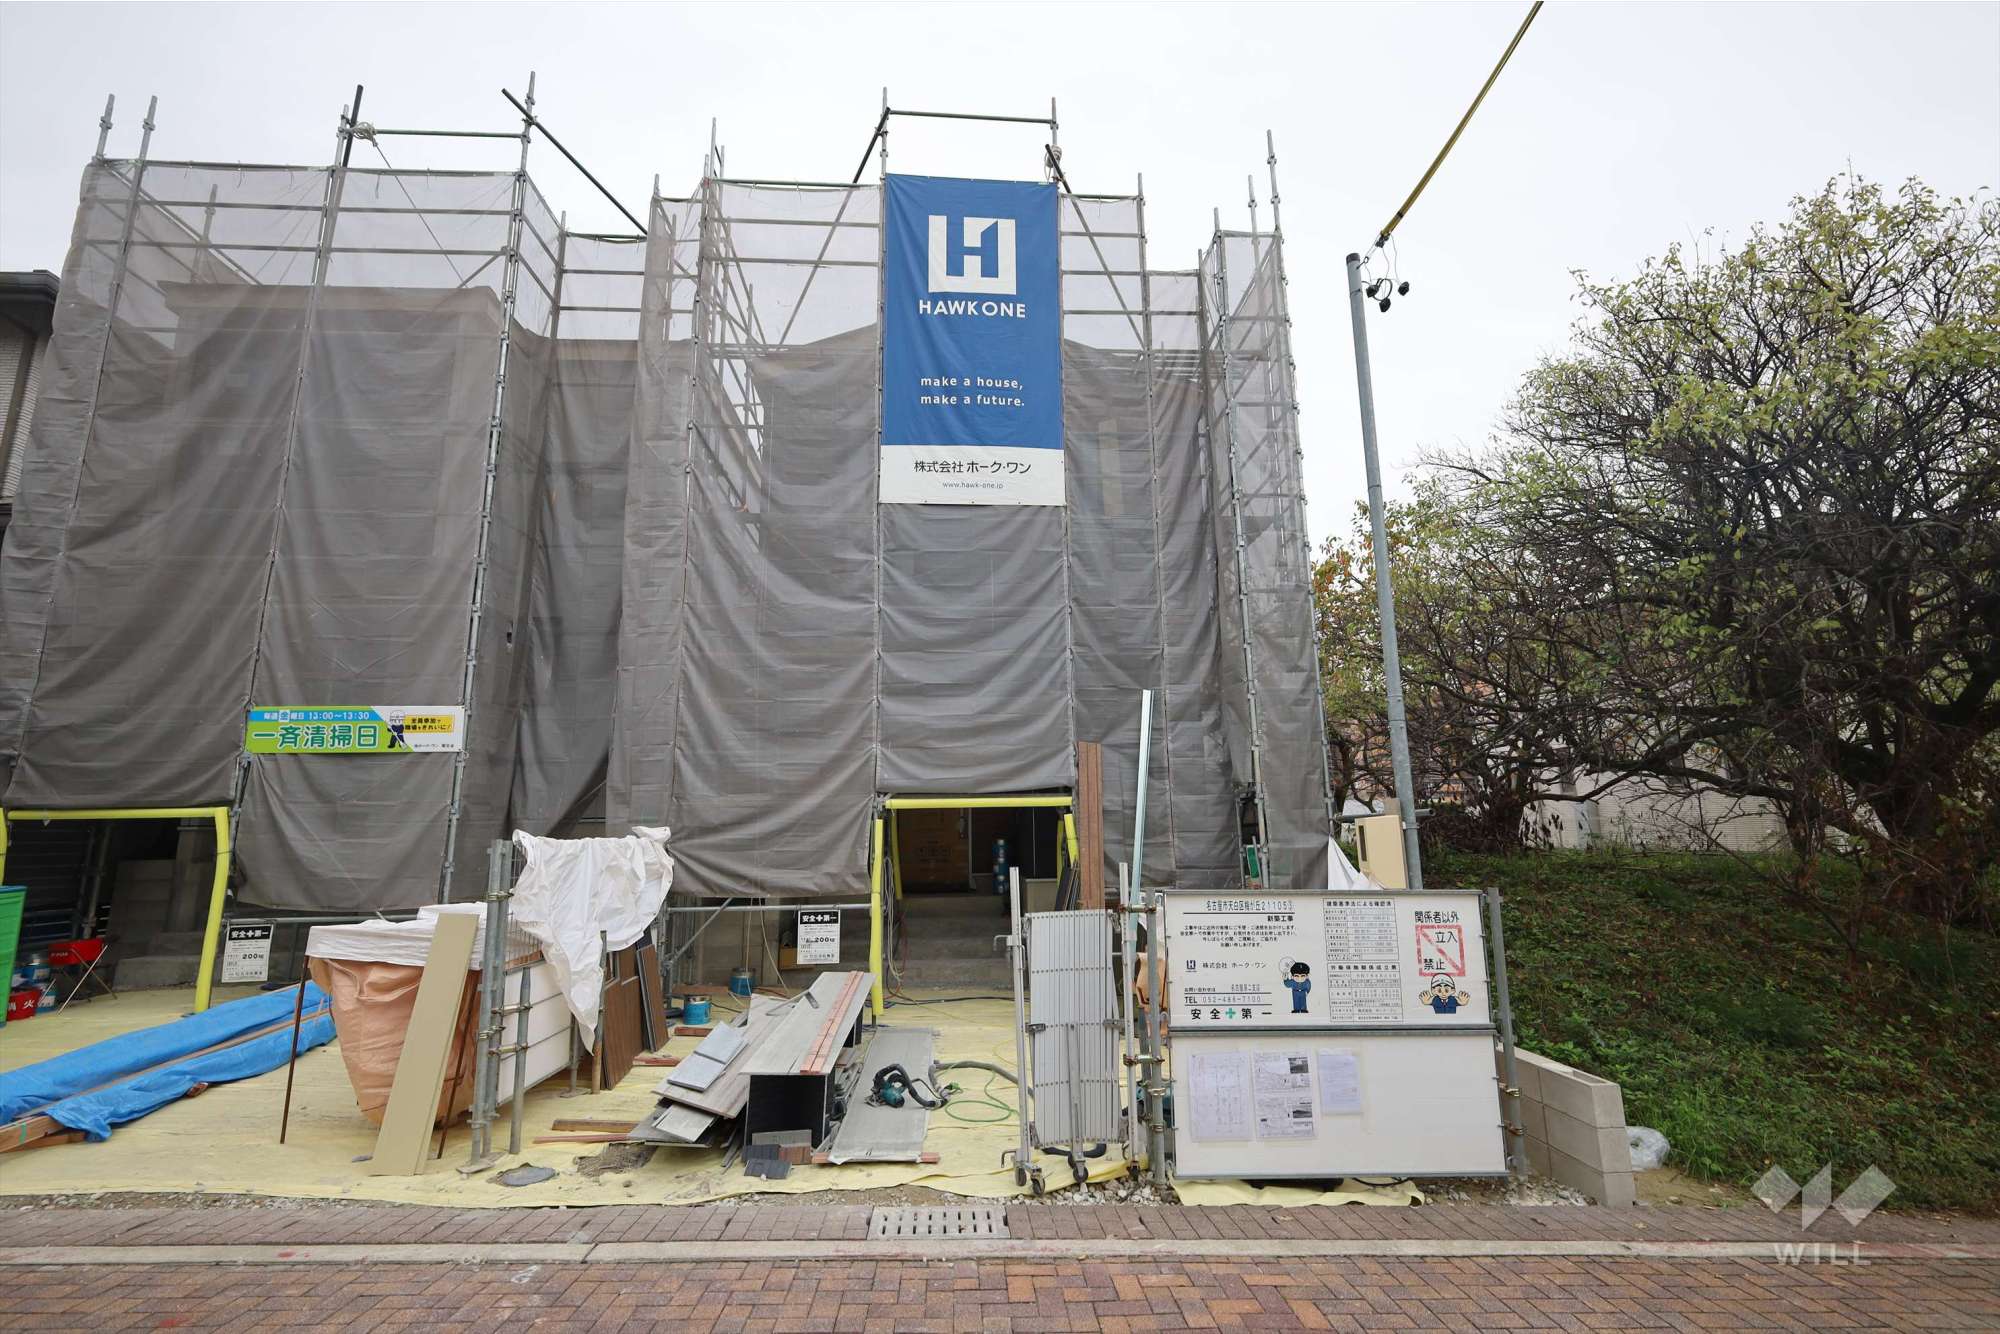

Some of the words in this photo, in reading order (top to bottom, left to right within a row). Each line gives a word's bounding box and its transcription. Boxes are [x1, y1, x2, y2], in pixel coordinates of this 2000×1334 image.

[920, 376, 957, 387] make
[963, 378, 971, 387] a
[976, 376, 1023, 391] house,
[920, 394, 957, 405] make
[963, 396, 971, 405] a
[976, 394, 1025, 407] future.
[942, 481, 1004, 489] www.hawk-one.jp
[253, 724, 378, 748] 一斉清掃日
[1414, 910, 1460, 924] 関係者以外
[1435, 931, 1458, 943] 立入
[1423, 958, 1446, 971] 禁止
[1184, 996, 1198, 1004] TEL
